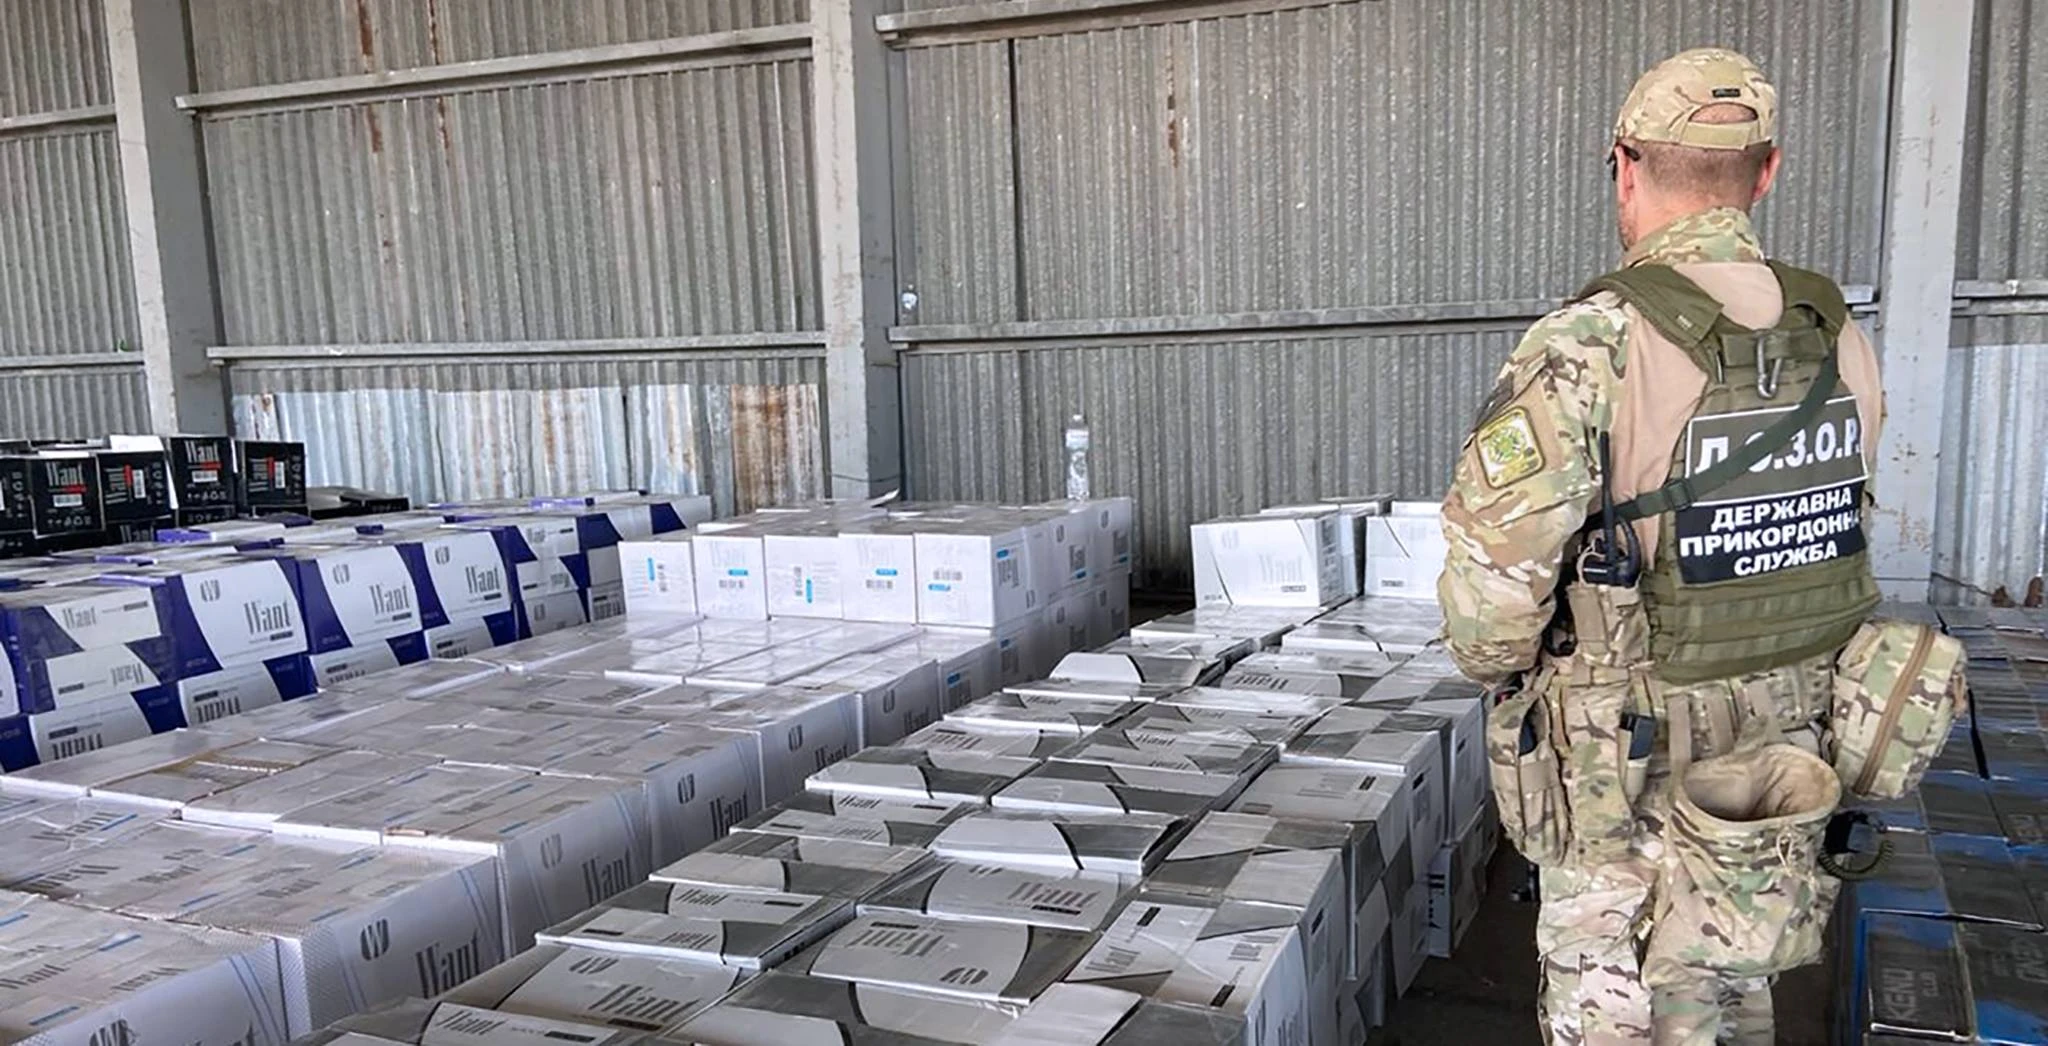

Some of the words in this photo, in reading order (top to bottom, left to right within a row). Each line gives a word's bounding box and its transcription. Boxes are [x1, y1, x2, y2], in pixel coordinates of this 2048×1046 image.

[184, 440, 219, 463] Want
[45, 461, 84, 486] Want
[1710, 487, 1852, 532] ДЕРЖАВНА
[1734, 540, 1838, 576] СЛУЖБА
[465, 565, 501, 594] Want
[369, 583, 411, 616] Want
[62, 605, 97, 630] Want
[244, 600, 292, 635] Want
[109, 662, 145, 687] Want
[710, 792, 750, 841] Want
[839, 795, 882, 809] Want
[580, 848, 633, 907] Want
[675, 888, 729, 907] Want
[1007, 881, 1101, 908] Want
[660, 930, 718, 949] Want
[845, 928, 945, 957] Want
[415, 929, 483, 999] Want
[586, 983, 701, 1023] Want
[435, 1010, 507, 1036] Want
